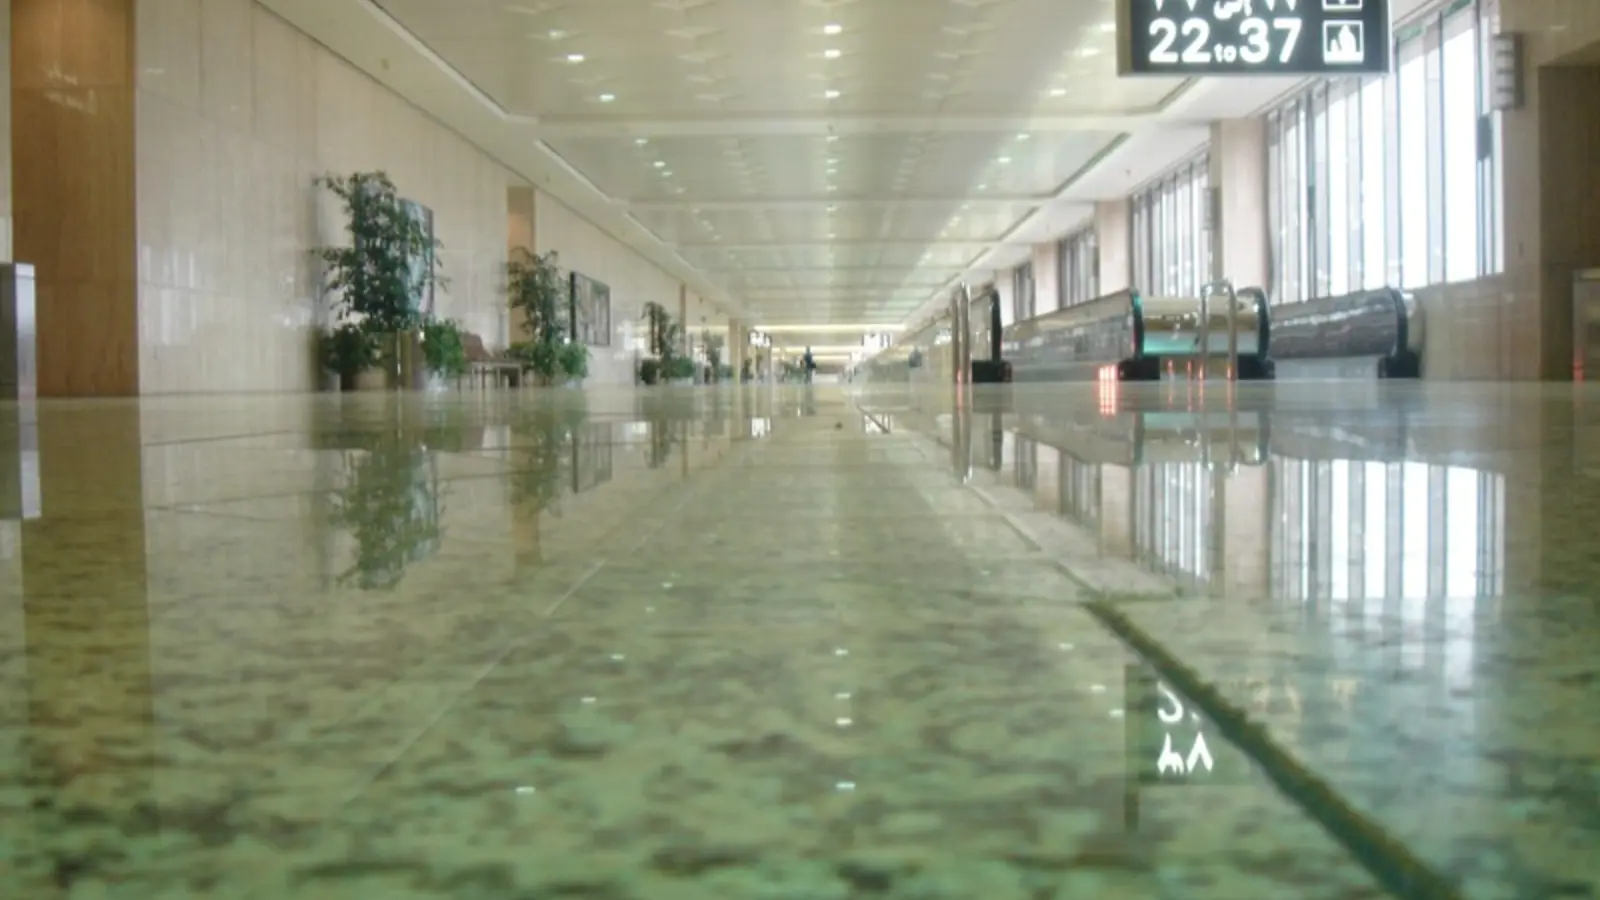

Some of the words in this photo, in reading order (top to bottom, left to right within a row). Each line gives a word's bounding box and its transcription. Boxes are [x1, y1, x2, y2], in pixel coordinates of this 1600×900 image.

[1148, 17, 1212, 64] 22
[1213, 43, 1238, 63] to
[1238, 17, 1303, 64] 37
